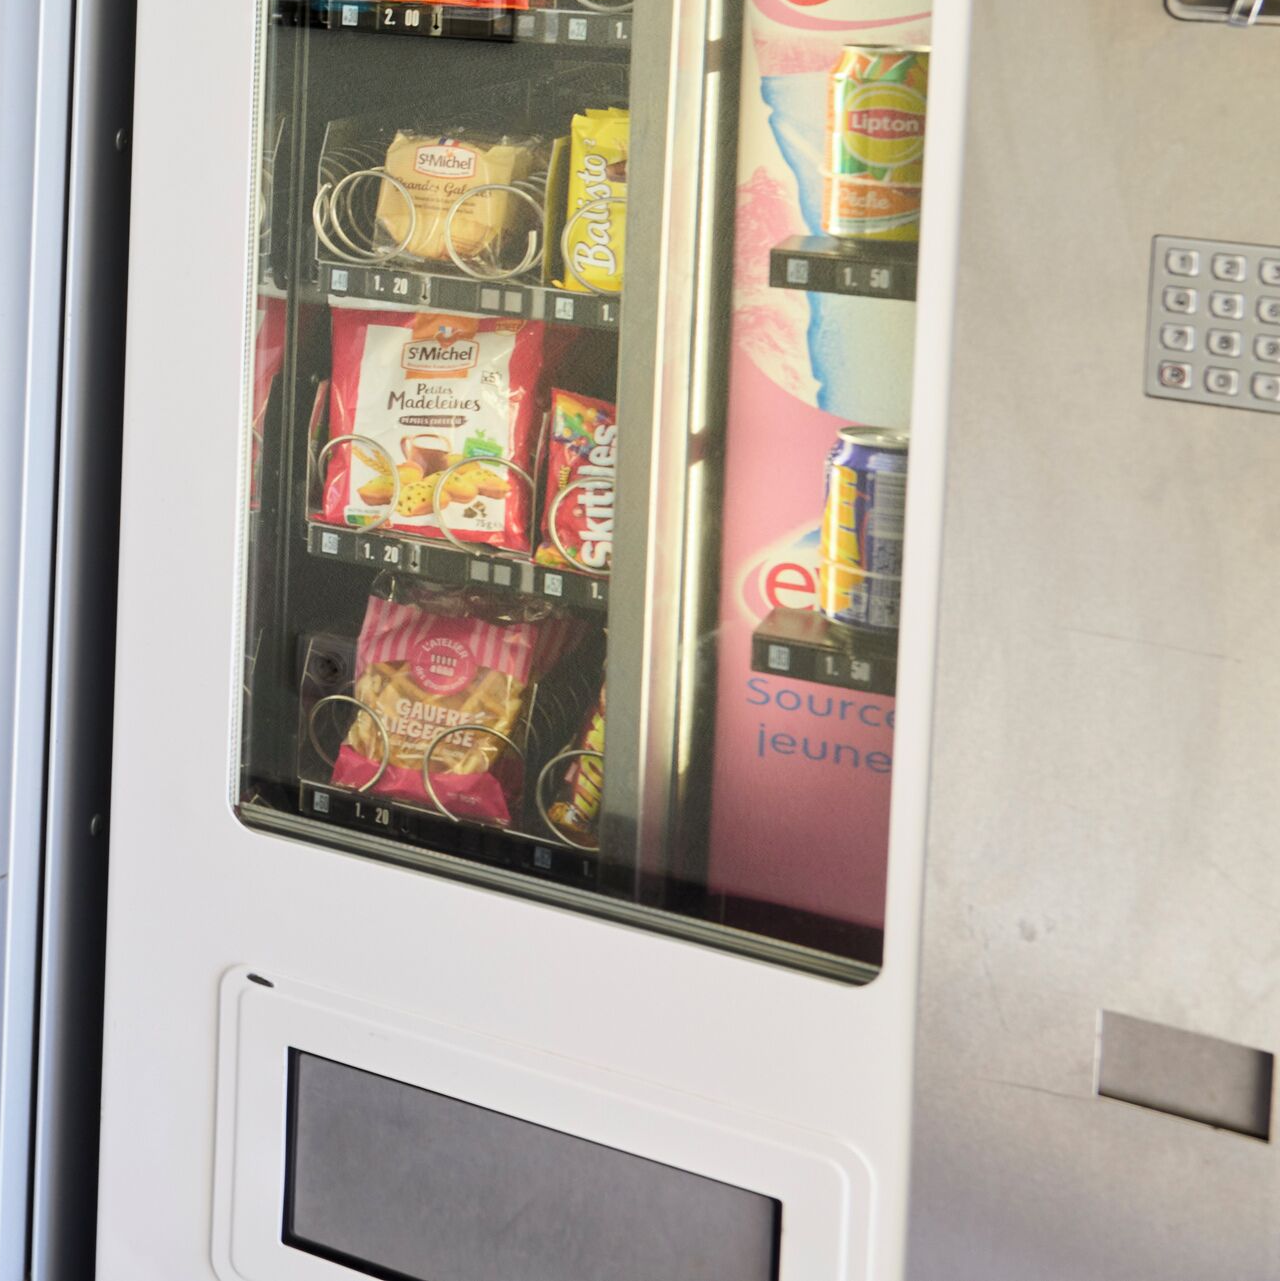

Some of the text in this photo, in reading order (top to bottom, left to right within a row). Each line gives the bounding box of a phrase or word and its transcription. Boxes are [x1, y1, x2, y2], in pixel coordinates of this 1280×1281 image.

[852, 112, 919, 133] Lipton
[572, 153, 617, 276] Balisto
[387, 391, 481, 412] Madeleines
